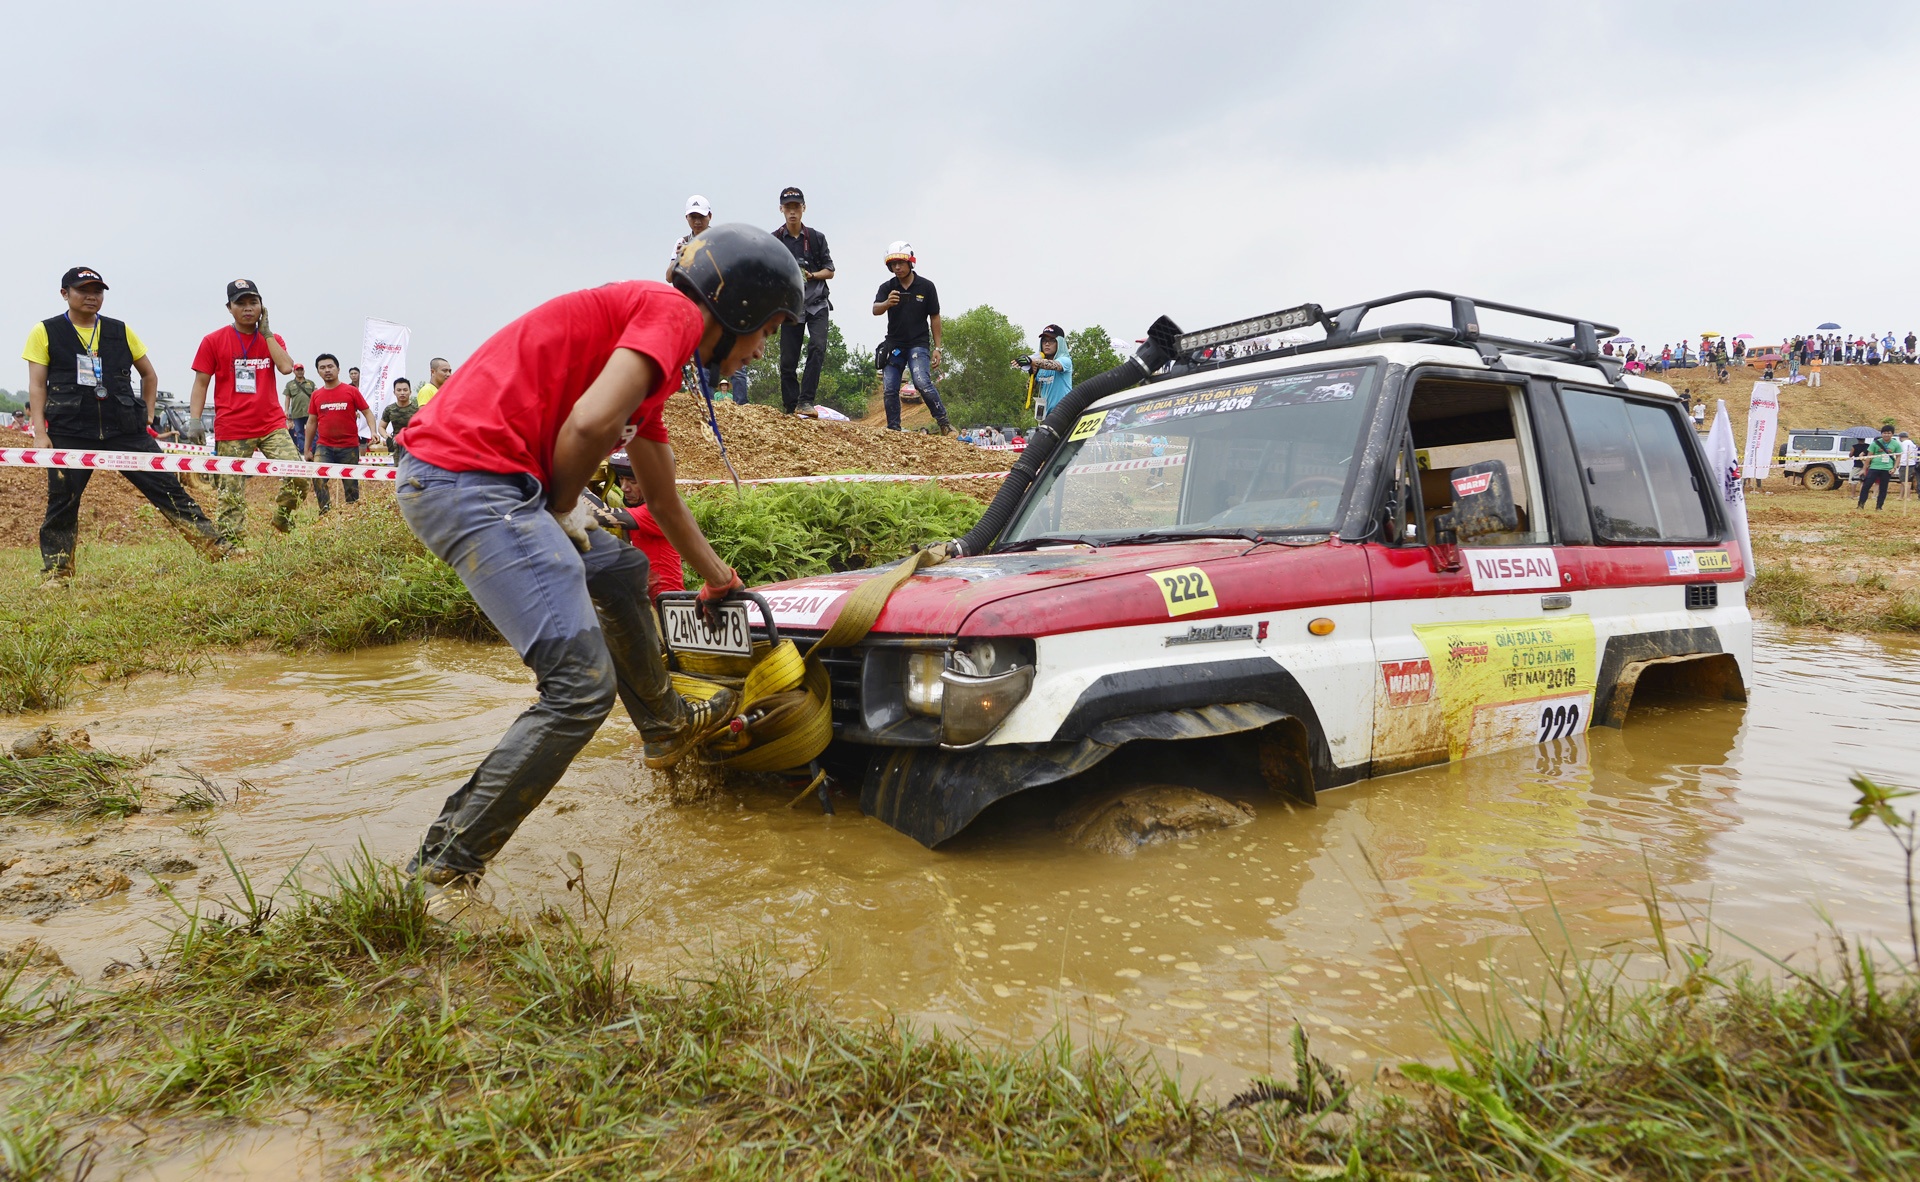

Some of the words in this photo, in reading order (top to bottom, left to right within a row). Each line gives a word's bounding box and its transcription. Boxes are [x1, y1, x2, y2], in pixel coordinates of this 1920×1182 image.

[1194, 402, 1217, 413] NAM
[1215, 396, 1254, 413] 2016
[1074, 417, 1101, 435] 222
[1457, 479, 1486, 492] WARN
[1476, 558, 1552, 579] NISSAN
[1698, 556, 1718, 566] Giti
[1163, 573, 1210, 603] 222
[1539, 630, 1553, 643] XE
[1389, 672, 1430, 693] WARN
[1526, 670, 1546, 685] NAM
[1546, 667, 1576, 689] 2016
